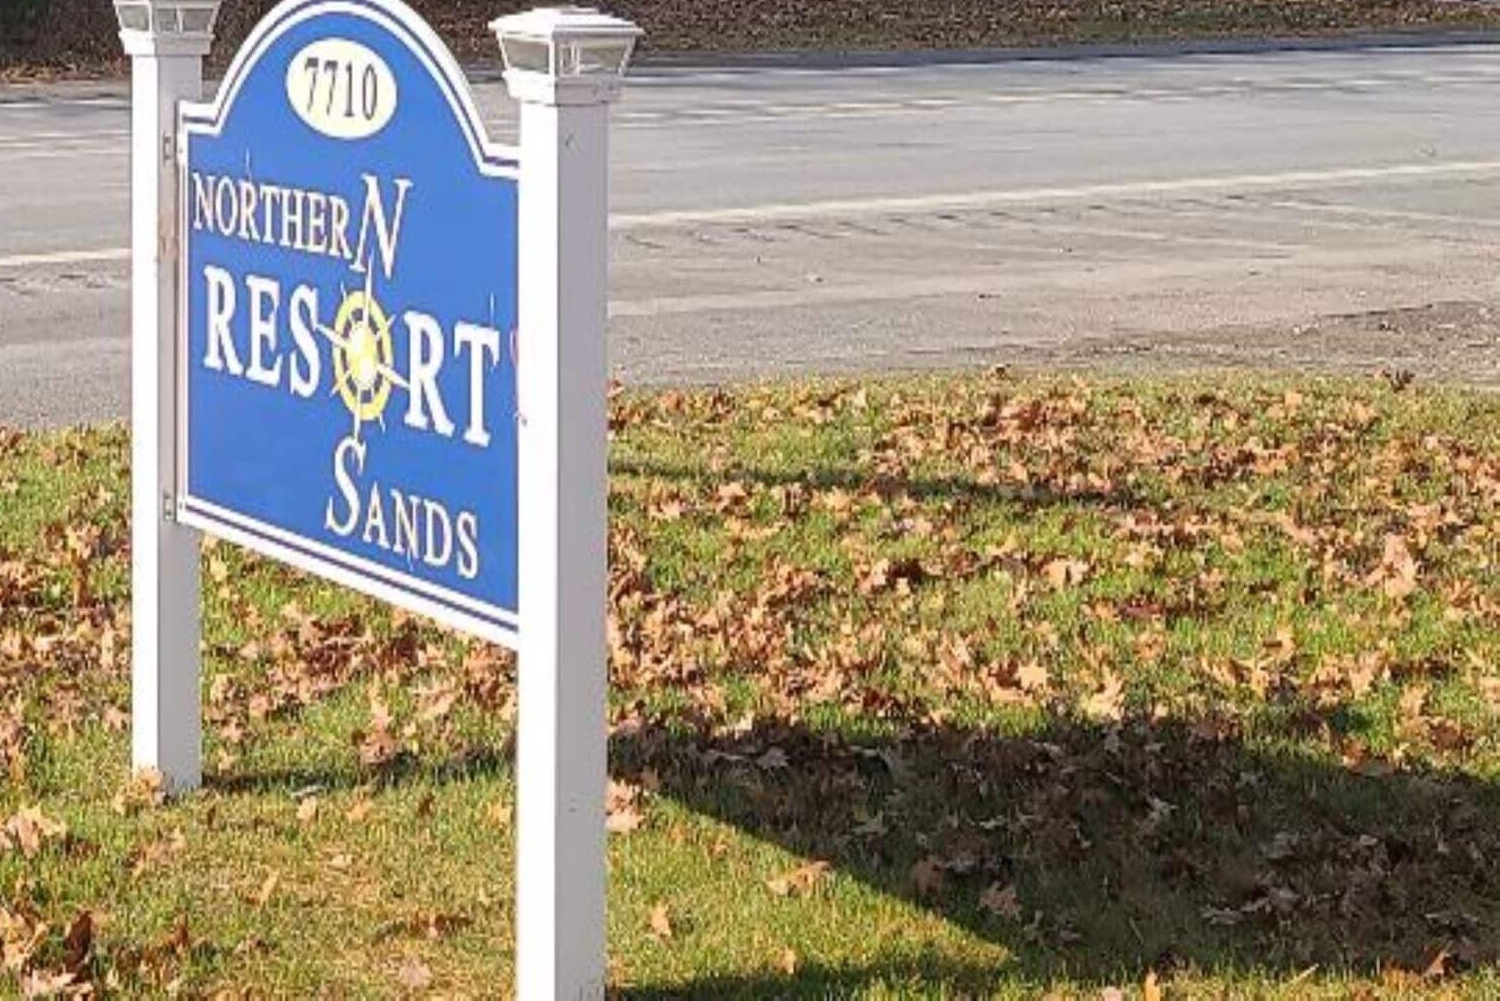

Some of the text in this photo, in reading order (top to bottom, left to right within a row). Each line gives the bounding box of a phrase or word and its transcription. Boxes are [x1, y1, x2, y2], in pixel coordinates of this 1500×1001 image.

[303, 56, 379, 122] 7710
[193, 172, 412, 279] NORTHERN
[325, 436, 479, 580] SANDS
